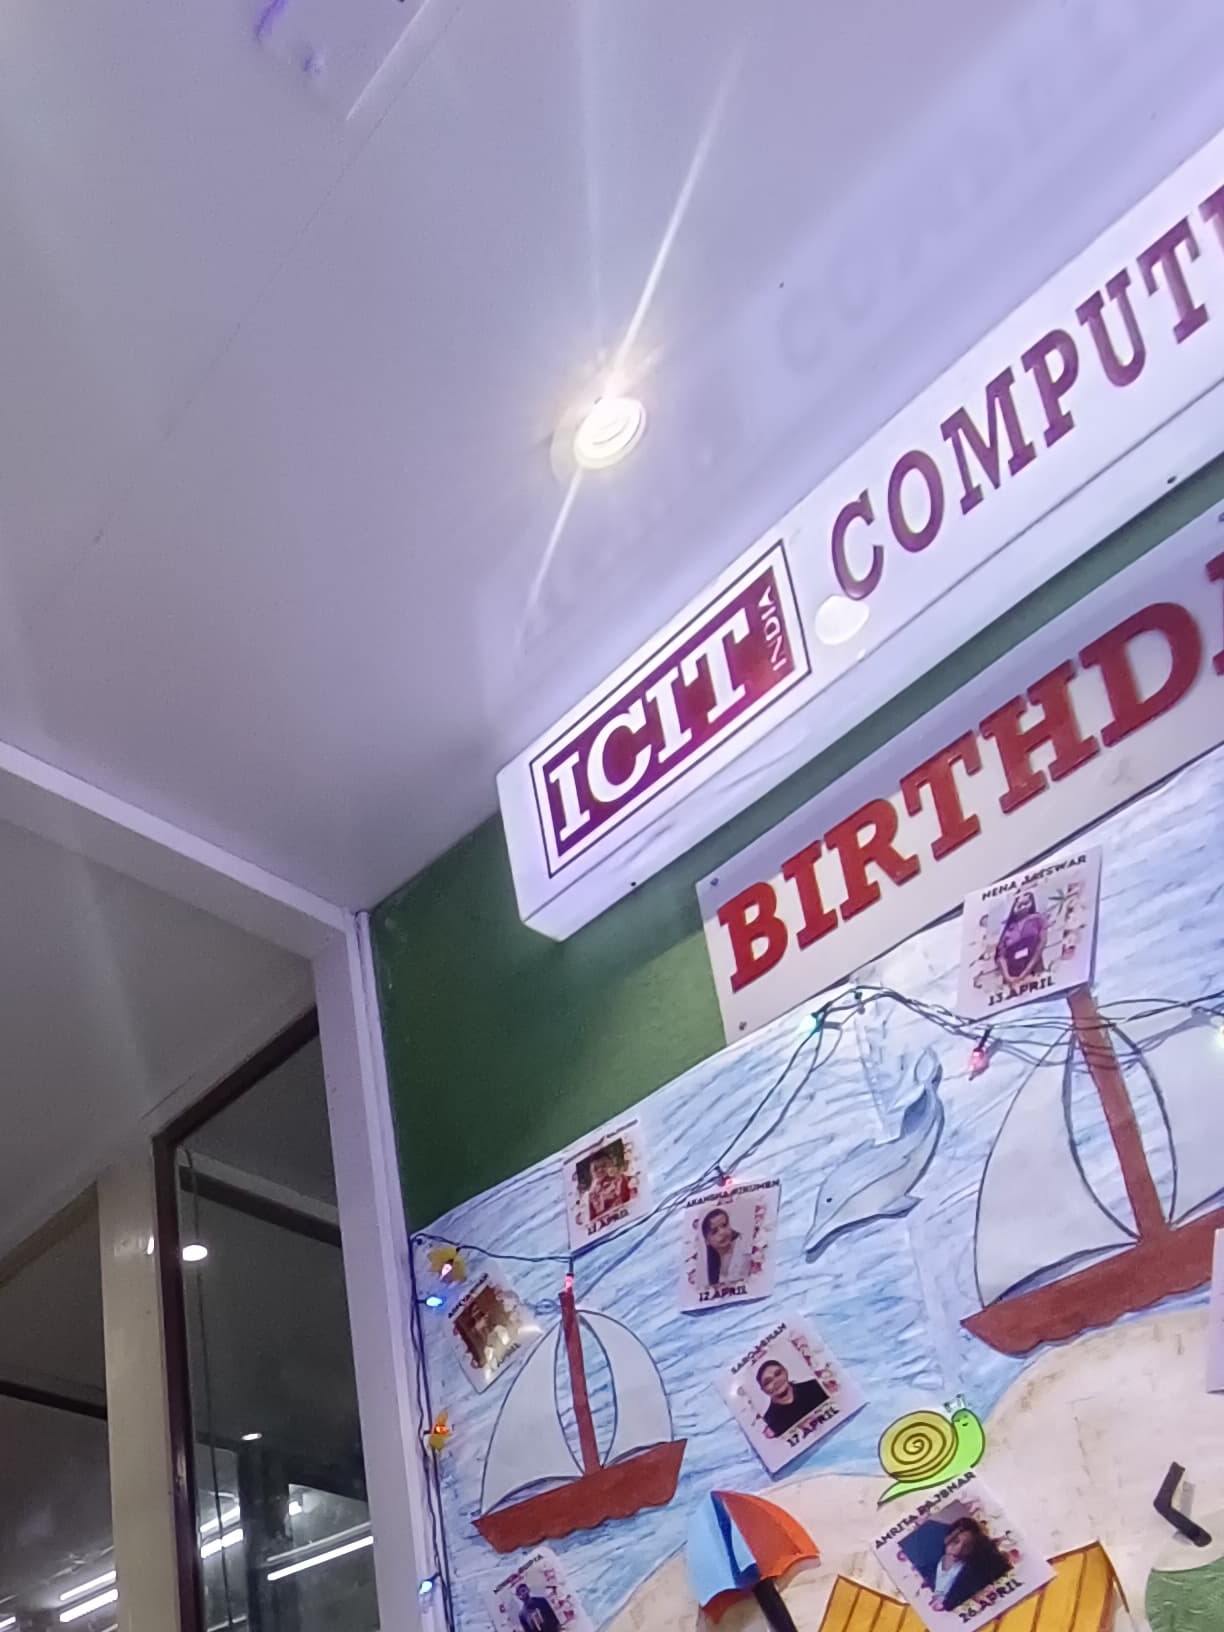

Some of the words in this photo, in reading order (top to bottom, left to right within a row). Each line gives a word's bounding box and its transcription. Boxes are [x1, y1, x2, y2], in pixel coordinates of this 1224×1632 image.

[547, 606, 753, 845] ICIT
[829, 184, 1224, 601] COMPUT
[757, 586, 788, 677] INDIA
[717, 551, 1224, 994] BIRTHD
[1005, 976, 1056, 1000] APRIL
[711, 1284, 748, 1300] APRIL
[787, 1433, 801, 1447] 17
[802, 1407, 840, 1439] APRIL
[875, 1513, 918, 1550] AMRITA
[958, 1608, 978, 1624] 26
[976, 1579, 1024, 1613] APRIL
